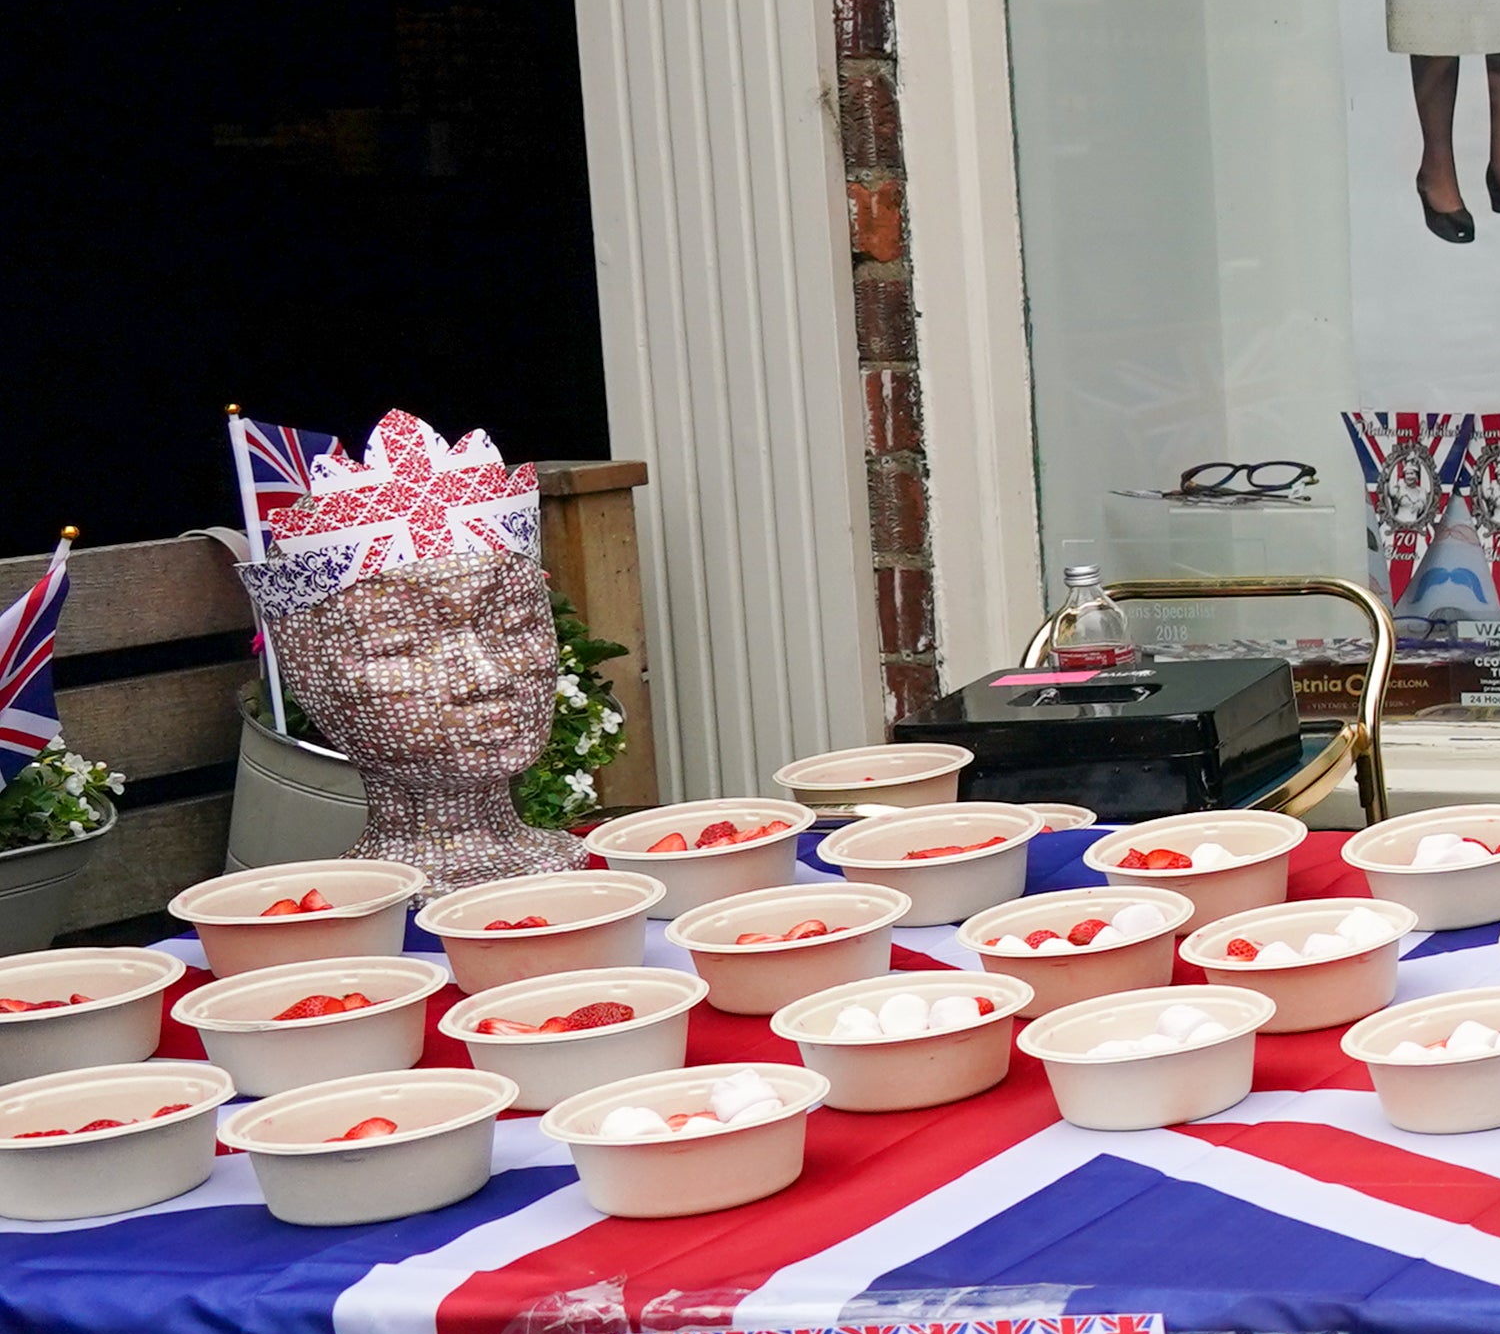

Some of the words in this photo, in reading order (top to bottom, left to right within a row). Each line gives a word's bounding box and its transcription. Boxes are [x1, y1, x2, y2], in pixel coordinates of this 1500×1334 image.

[1396, 532, 1416, 547] 70
[1156, 625, 1189, 642] 2018
[1470, 695, 1481, 704] 24
